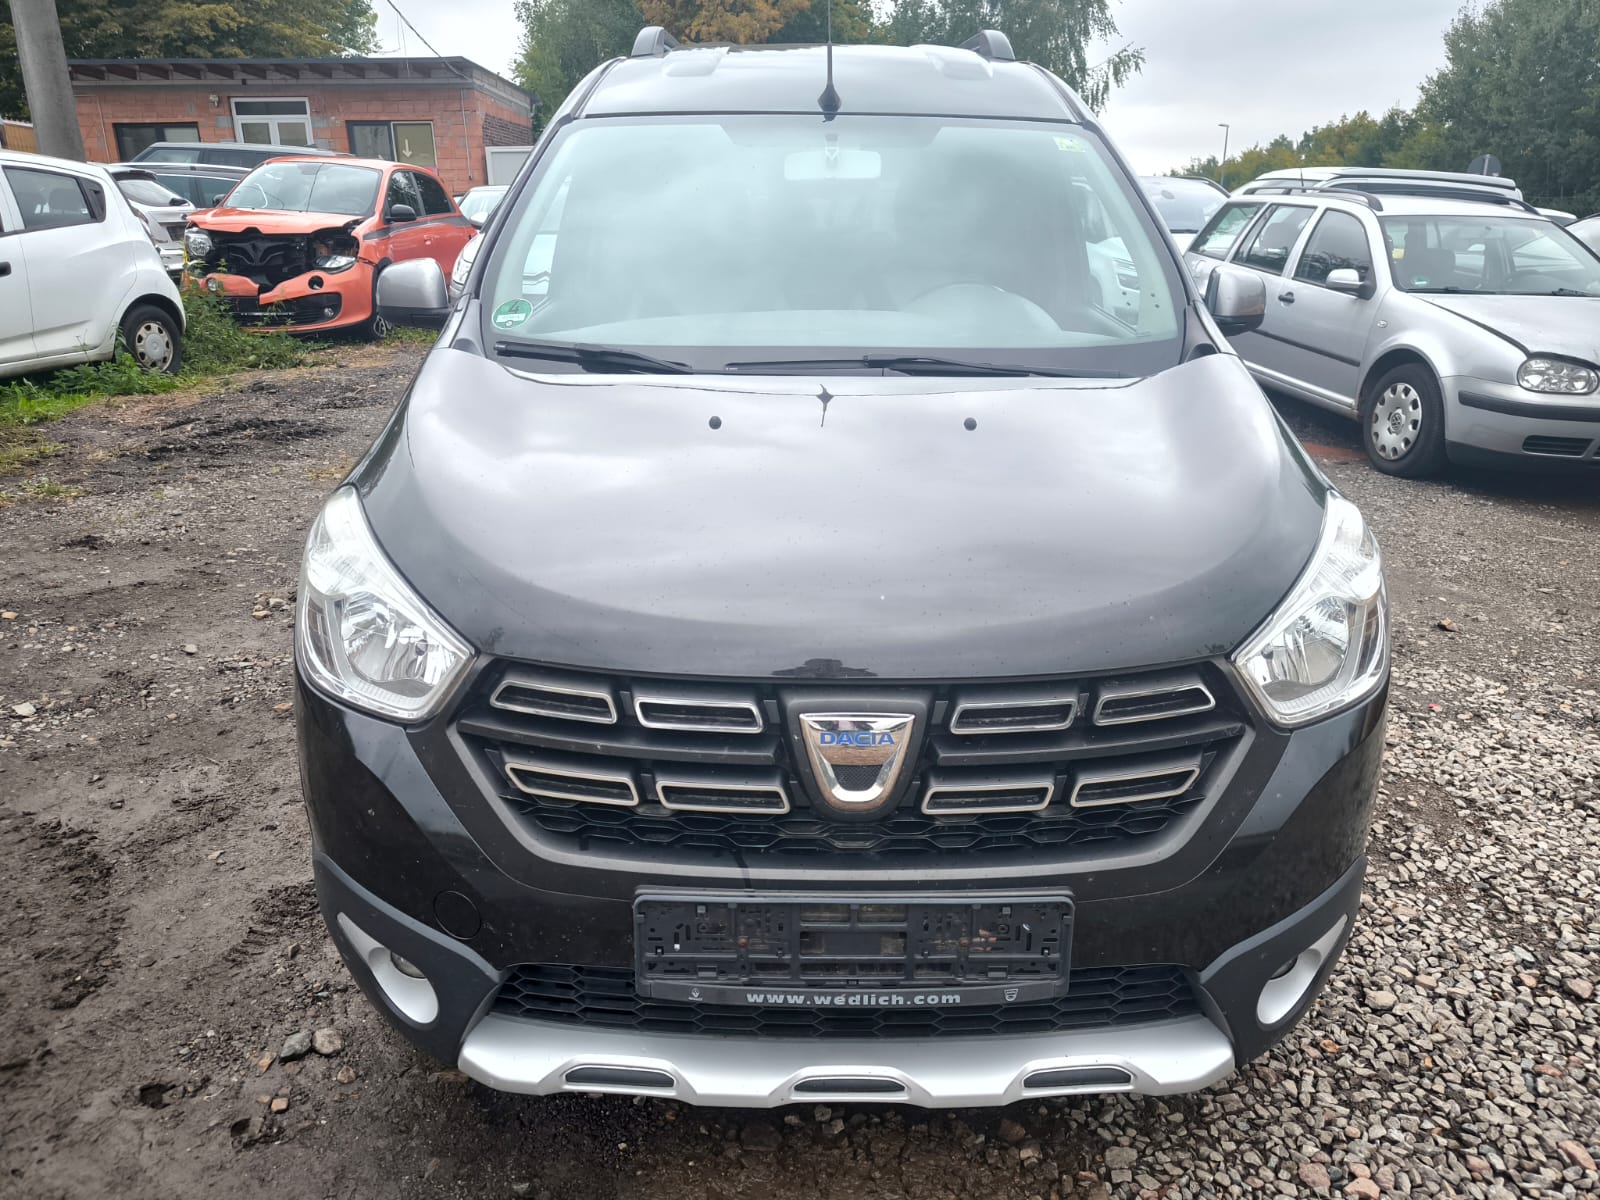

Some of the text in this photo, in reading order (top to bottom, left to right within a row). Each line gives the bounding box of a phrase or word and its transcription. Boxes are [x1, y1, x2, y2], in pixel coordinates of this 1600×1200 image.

[508, 300, 520, 314] 4
[819, 732, 895, 747] DACIA
[746, 993, 961, 1006] www.wedlich.com
